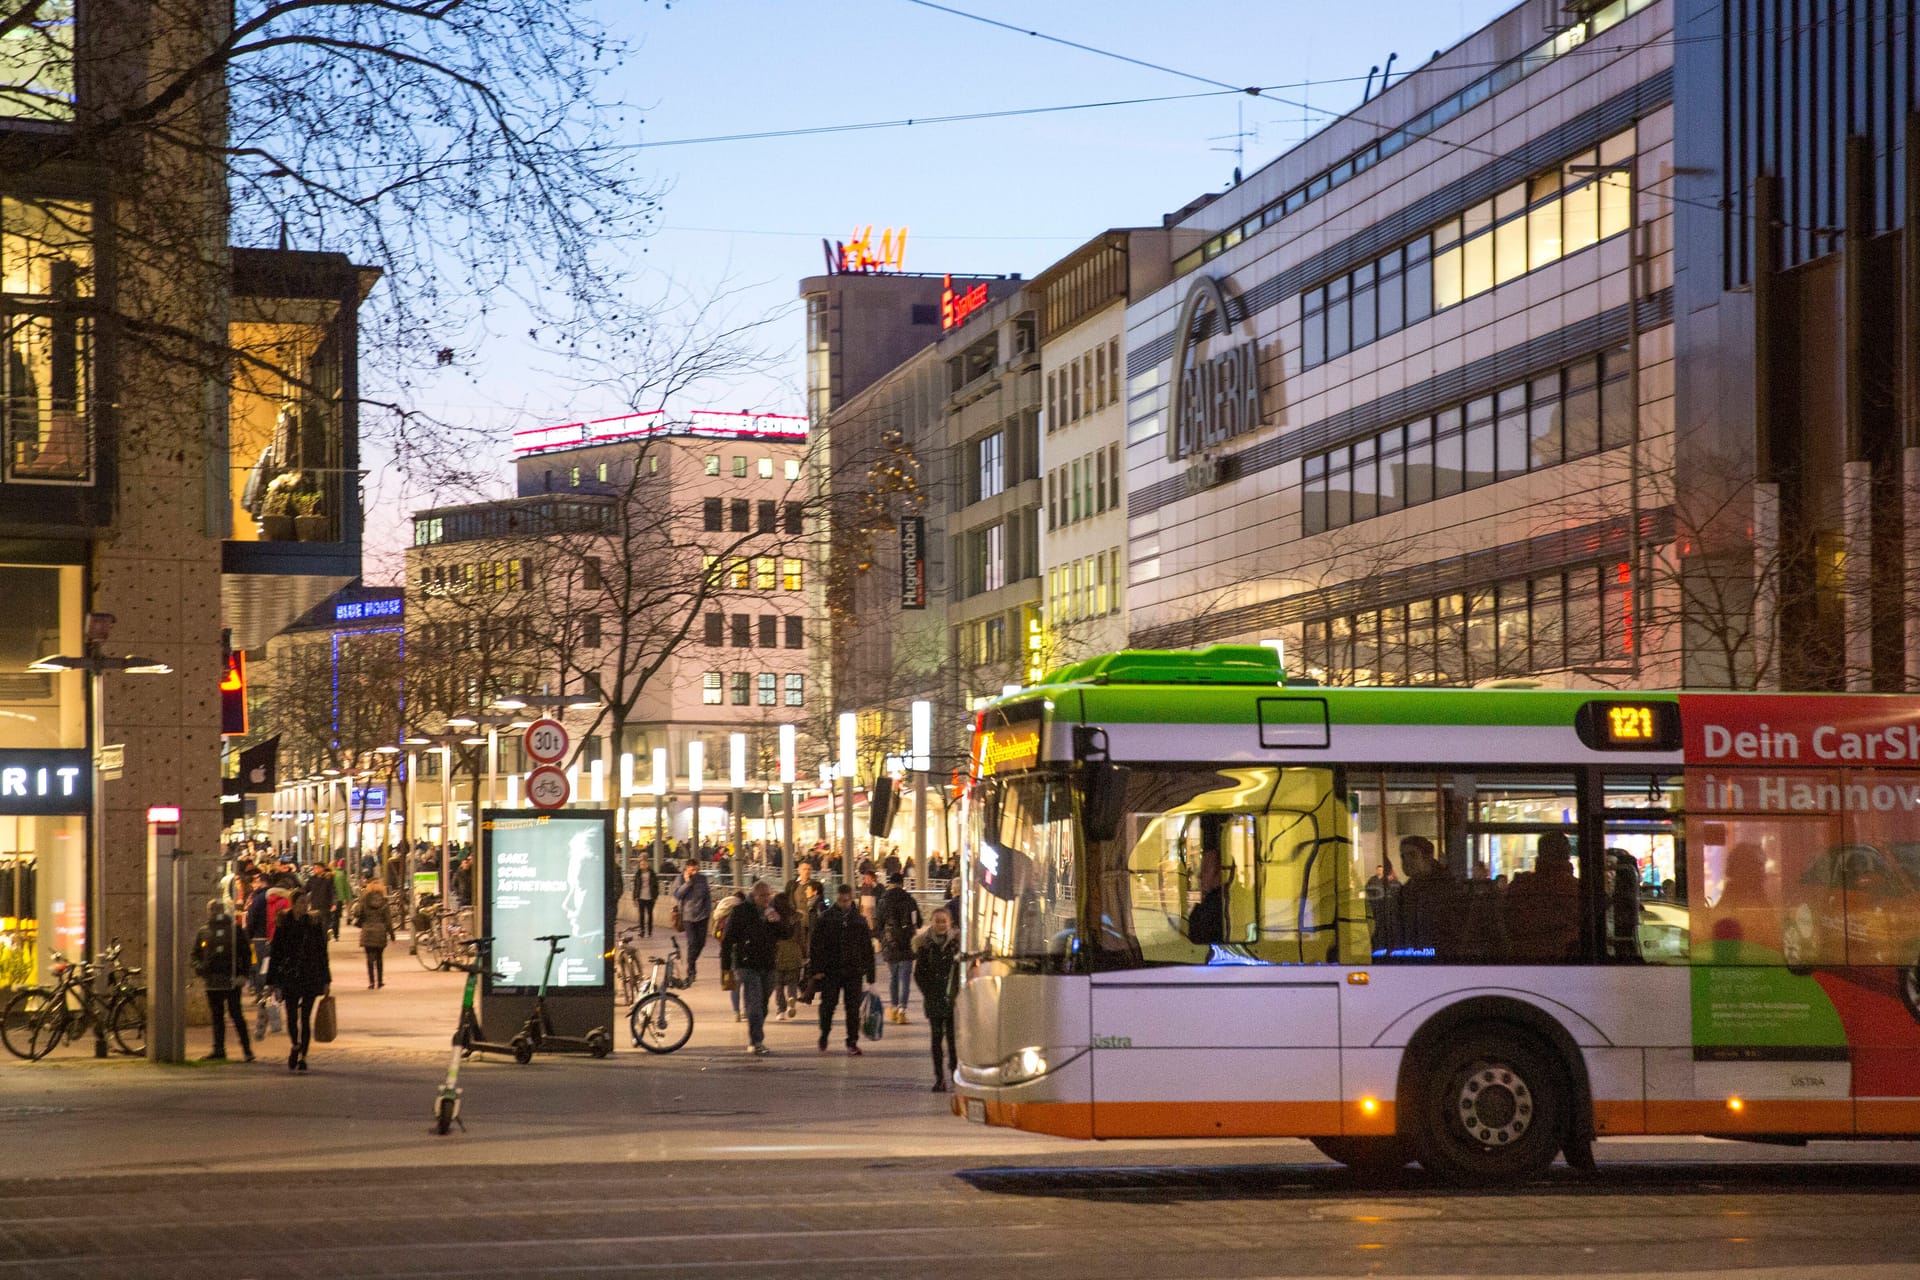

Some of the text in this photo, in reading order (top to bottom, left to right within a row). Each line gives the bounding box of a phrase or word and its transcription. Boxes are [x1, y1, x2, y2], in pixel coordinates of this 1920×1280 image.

[841, 225, 908, 272] H&M
[1180, 339, 1261, 455] GALERIA
[902, 520, 918, 606] Hugendubel
[1610, 707, 1652, 737] 121
[1704, 723, 1800, 759] Dein
[2, 767, 79, 796] RIT
[1705, 774, 1920, 811] in Hannov
[497, 852, 529, 865] GANZ
